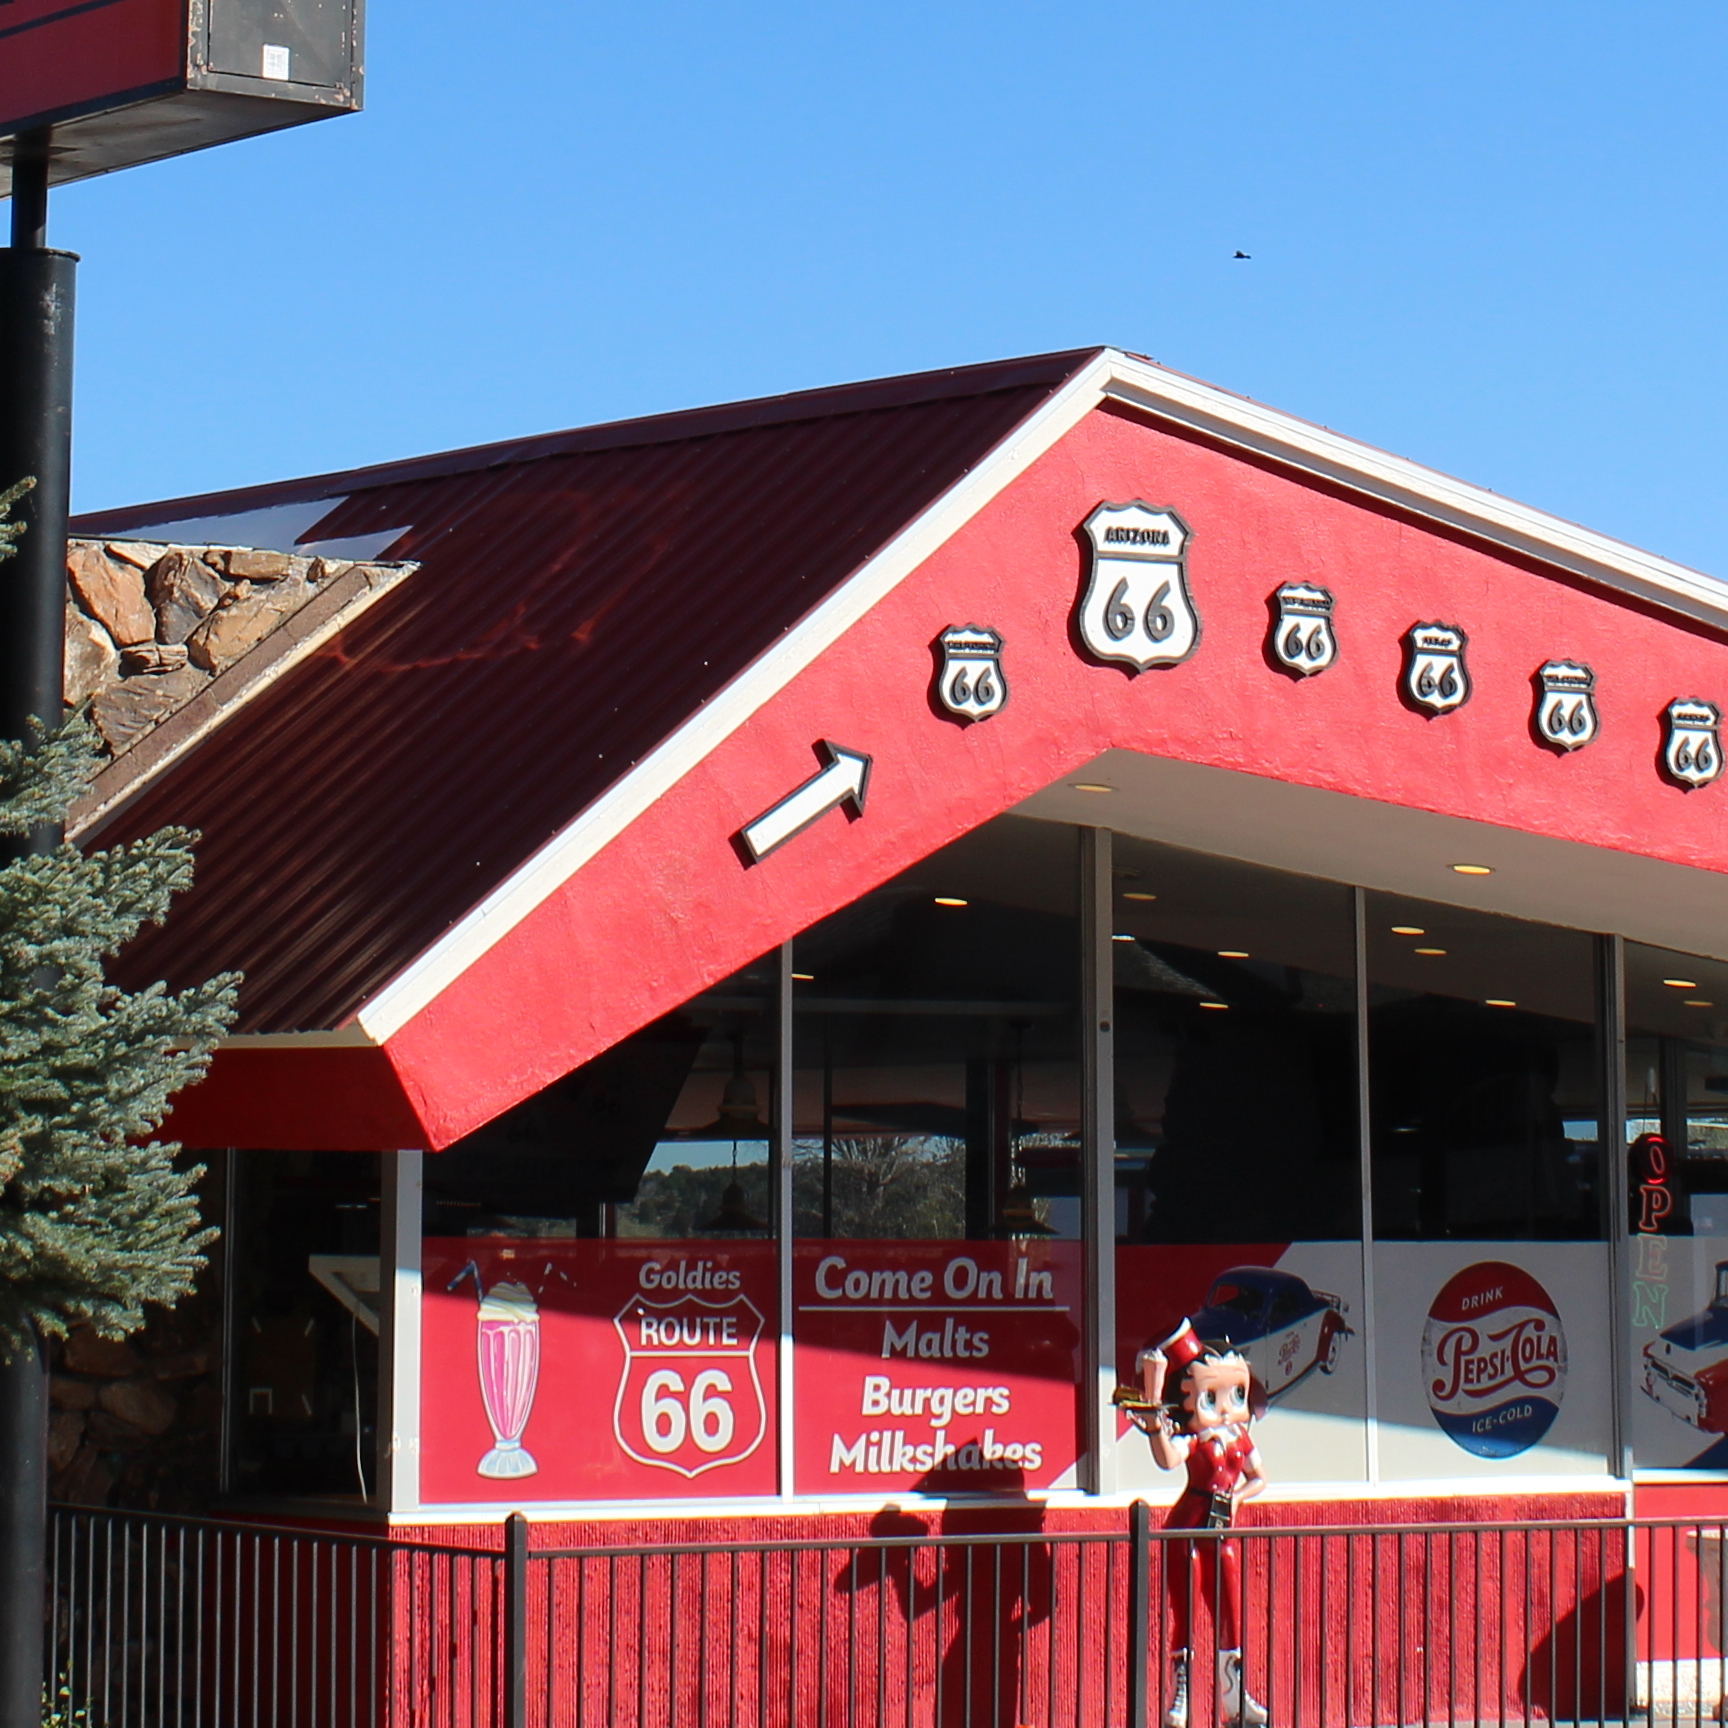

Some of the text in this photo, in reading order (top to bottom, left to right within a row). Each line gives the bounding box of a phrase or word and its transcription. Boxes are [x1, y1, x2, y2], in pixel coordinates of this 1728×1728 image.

[1103, 526, 1171, 547] ARIZONA
[1101, 575, 1176, 644] 66
[1283, 621, 1326, 662] 66
[949, 665, 996, 706] 66
[1416, 660, 1459, 700] 66
[1547, 698, 1588, 737] 66
[1674, 735, 1713, 774] 66
[1633, 1136, 1673, 1330] OPEN
[639, 1261, 741, 1291] Goldies
[815, 1257, 1053, 1301] Come On In
[1461, 1286, 1504, 1311] DRINK
[640, 1317, 739, 1347] ROUTE
[881, 1319, 990, 1360] Malts
[640, 1368, 736, 1455] 66
[860, 1374, 1012, 1428] Burgers
[1472, 1404, 1533, 1434] ICE-COLD
[829, 1429, 1044, 1476] Milkshakes
